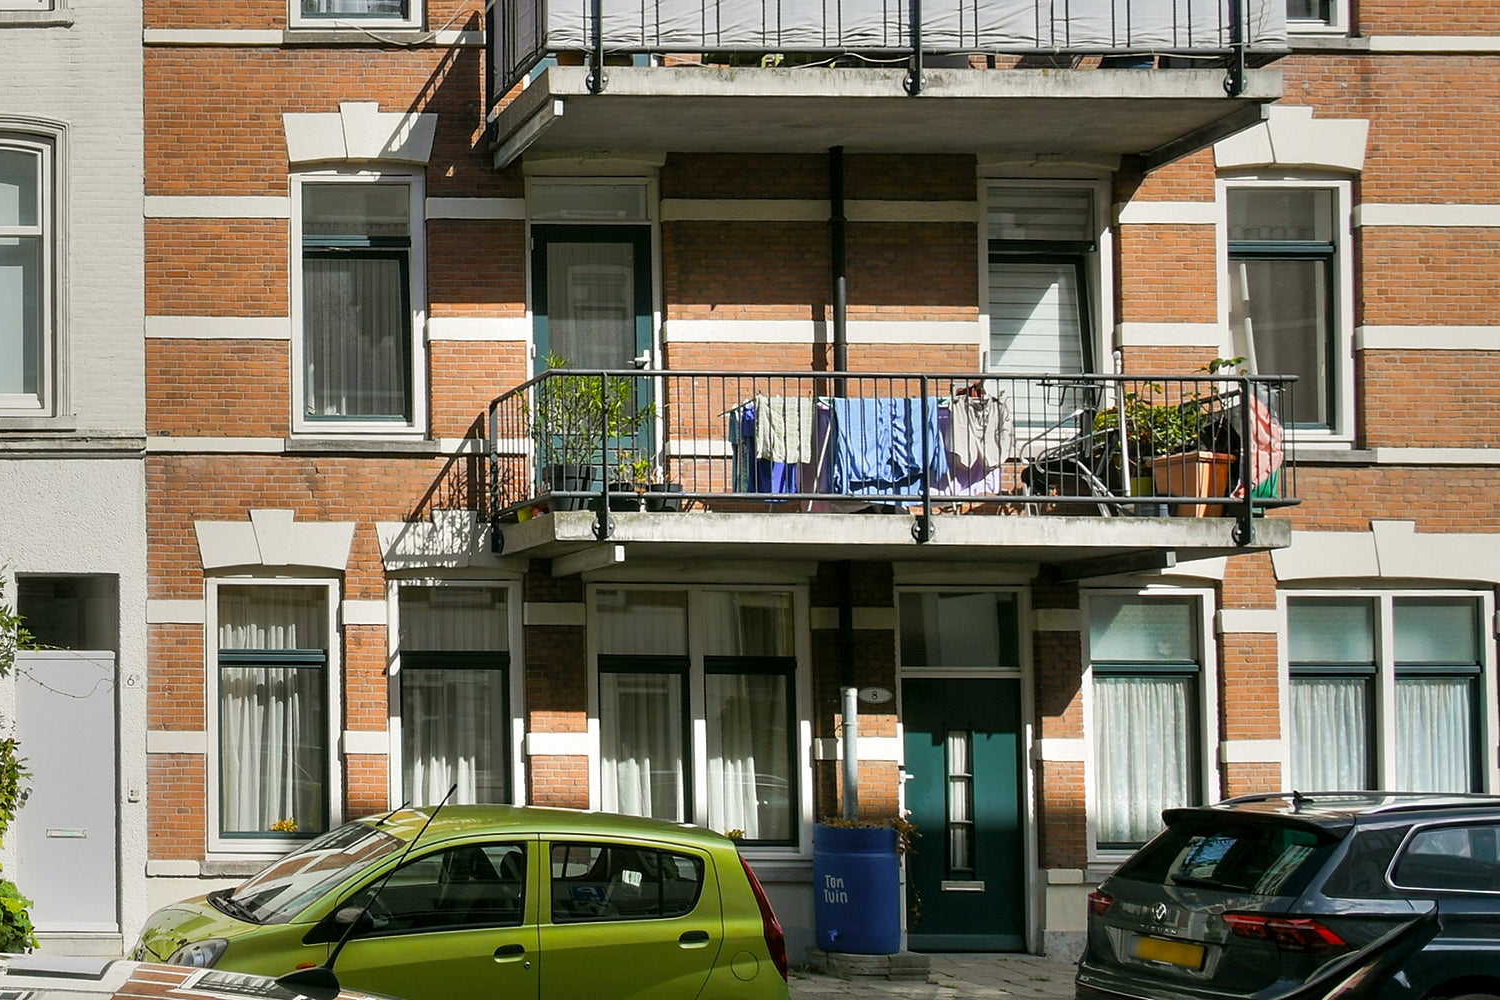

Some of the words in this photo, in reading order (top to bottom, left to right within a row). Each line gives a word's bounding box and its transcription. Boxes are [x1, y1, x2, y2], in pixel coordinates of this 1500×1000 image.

[871, 690, 878, 700] 8
[825, 874, 844, 888] Ton
[823, 889, 848, 904] Tuin
